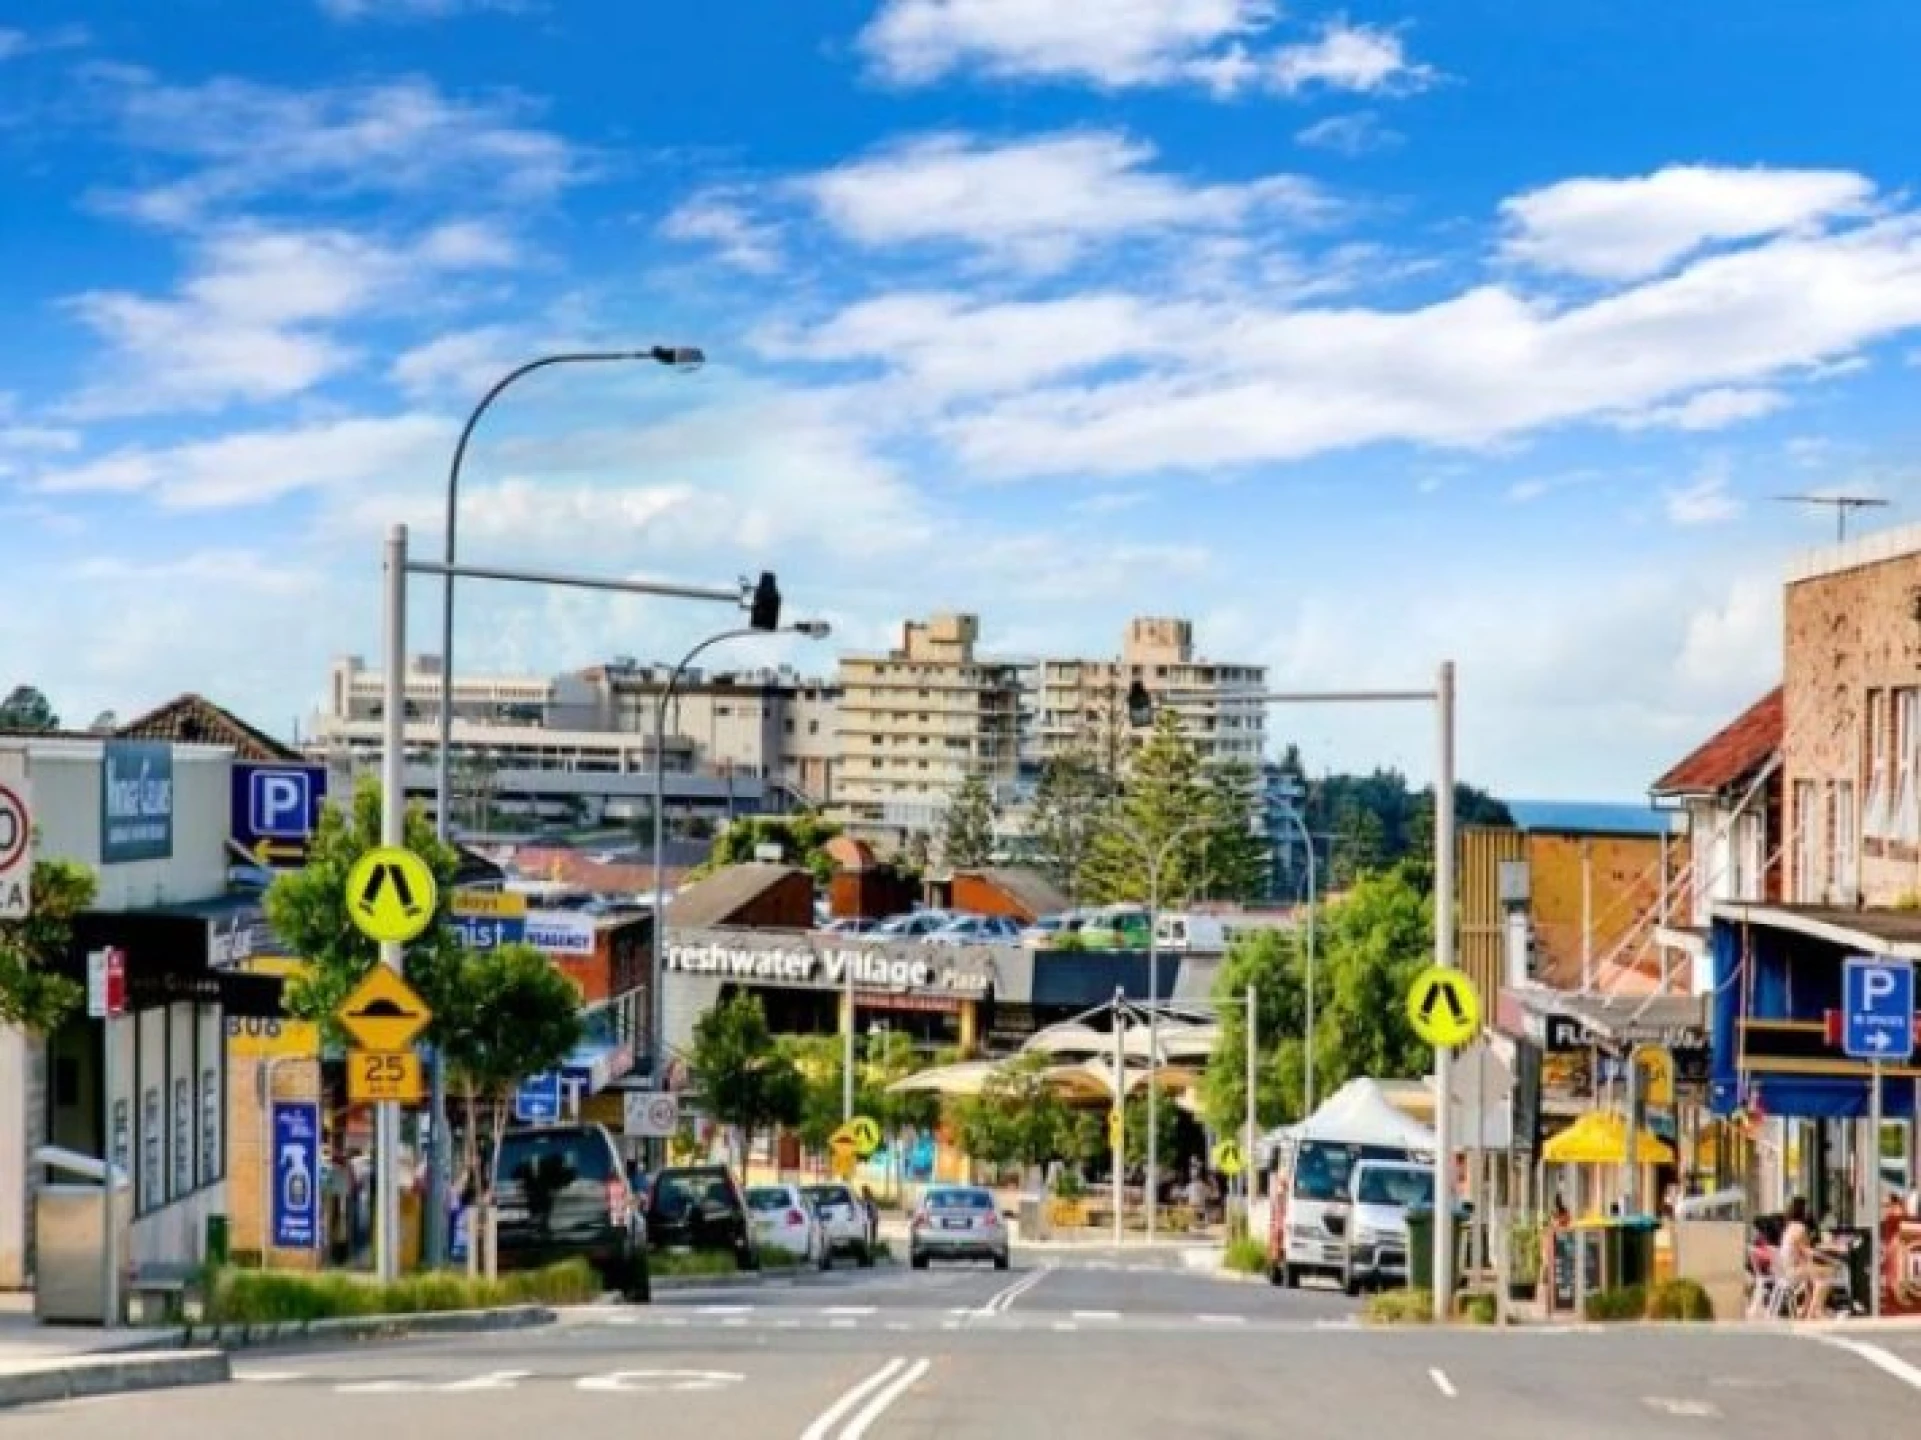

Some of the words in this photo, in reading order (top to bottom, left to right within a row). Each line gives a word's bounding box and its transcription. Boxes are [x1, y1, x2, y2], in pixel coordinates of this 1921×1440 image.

[264, 777, 299, 828] P
[824, 949, 929, 985] Village
[1863, 969, 1896, 1011] P
[364, 1056, 406, 1082] 25
